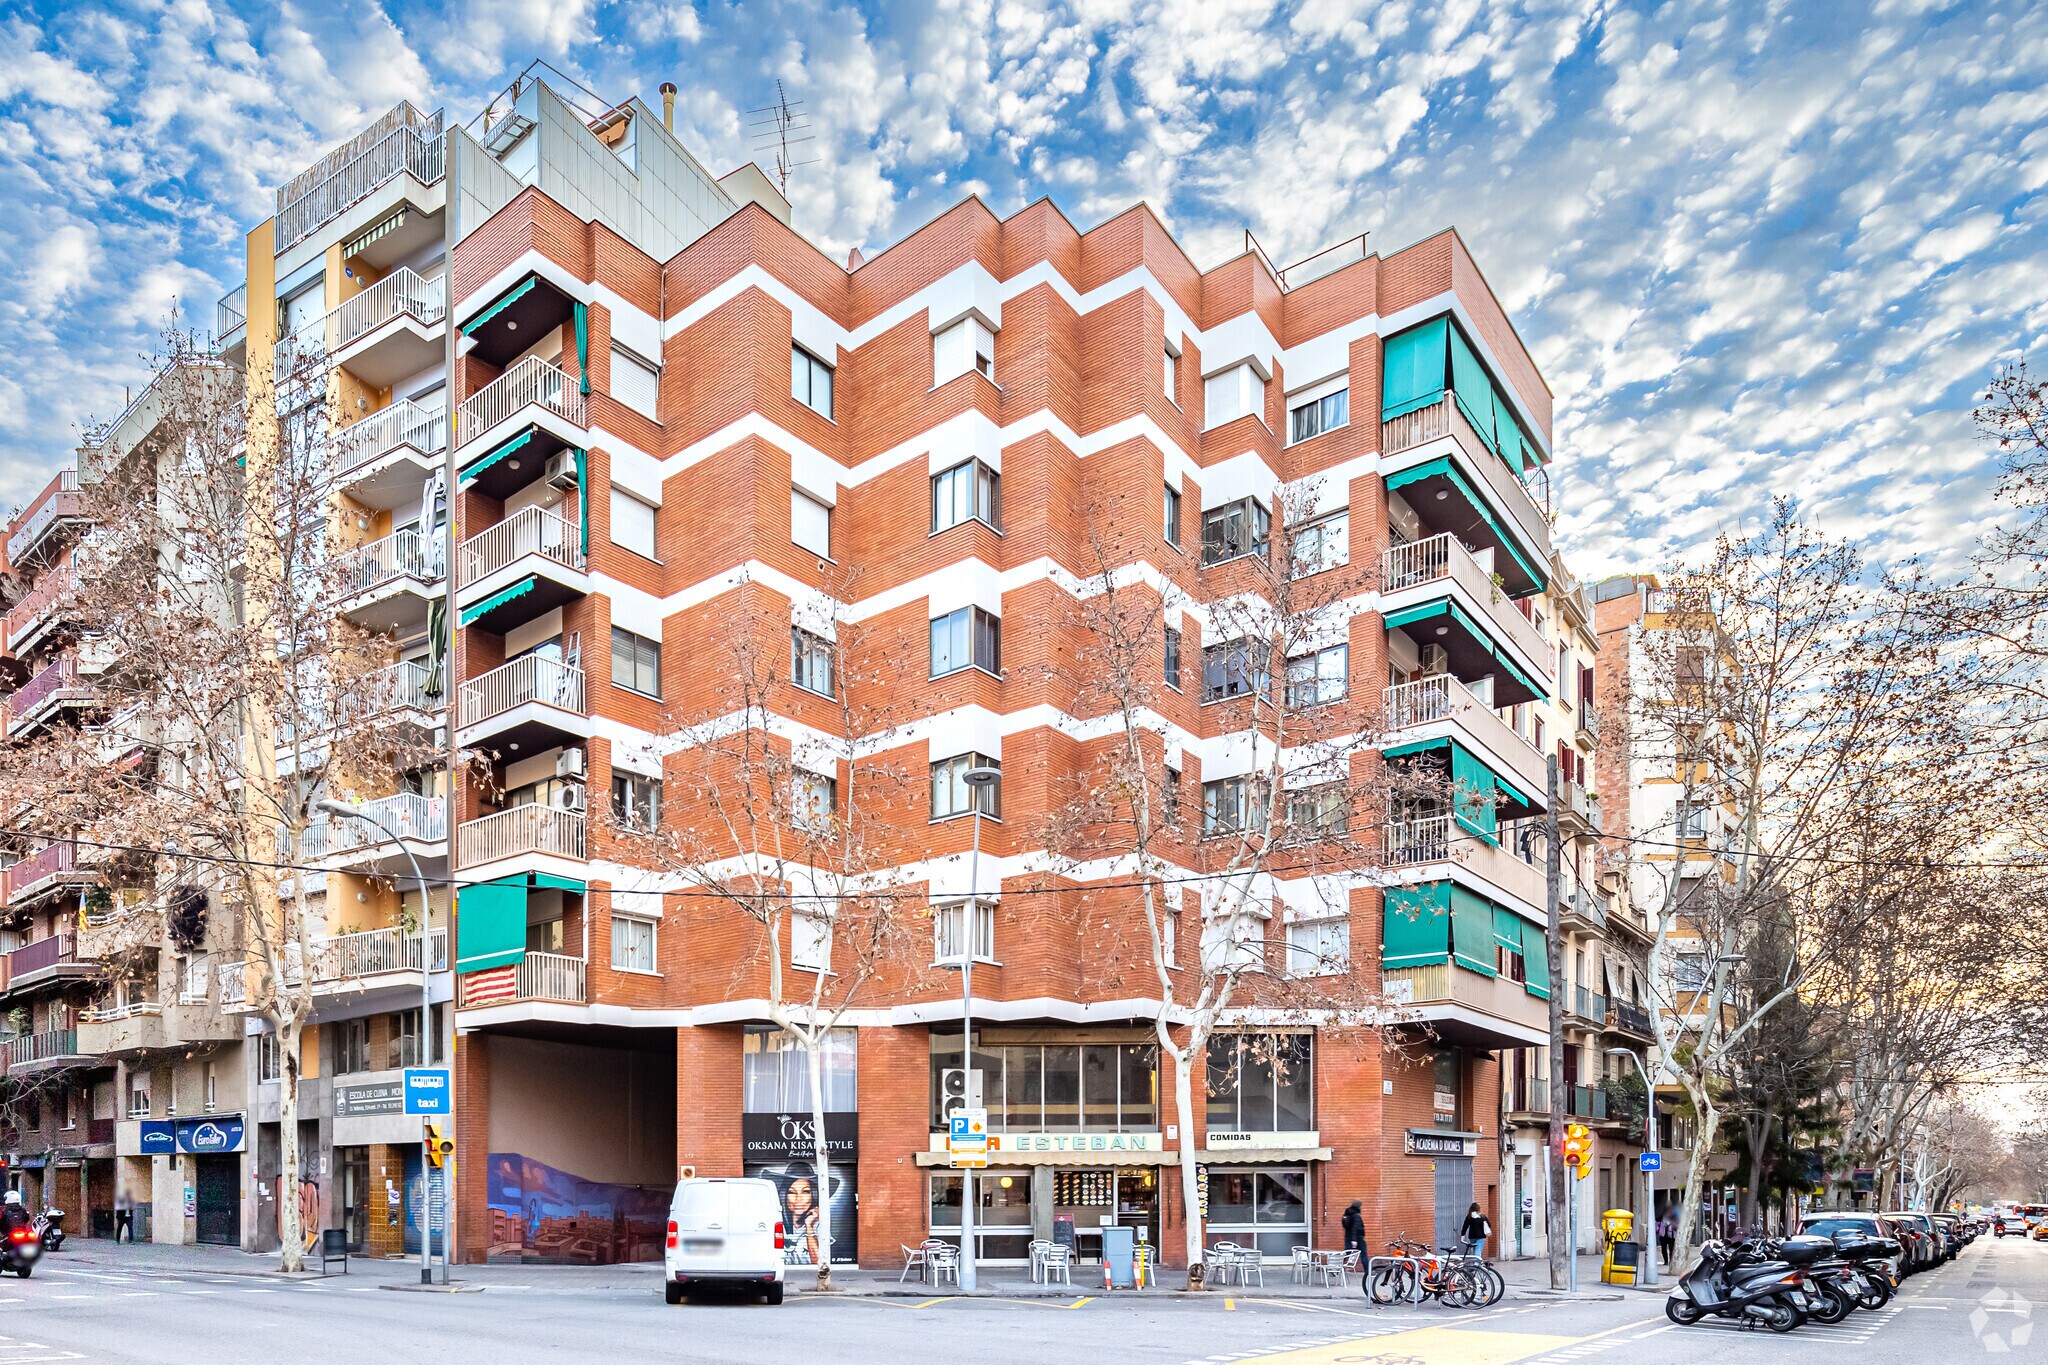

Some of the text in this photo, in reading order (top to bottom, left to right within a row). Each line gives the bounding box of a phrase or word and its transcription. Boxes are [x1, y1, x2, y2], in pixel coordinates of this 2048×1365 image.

[349, 1090, 365, 1100] ESCOLA
[366, 1089, 373, 1098] DE
[417, 1098, 438, 1108] taxi
[954, 1119, 965, 1133] P
[197, 1131, 222, 1145] EuroTaller
[1016, 1135, 1147, 1150] ESTEBAN
[747, 1141, 788, 1150] OKSANA
[790, 1141, 816, 1150] KISA
